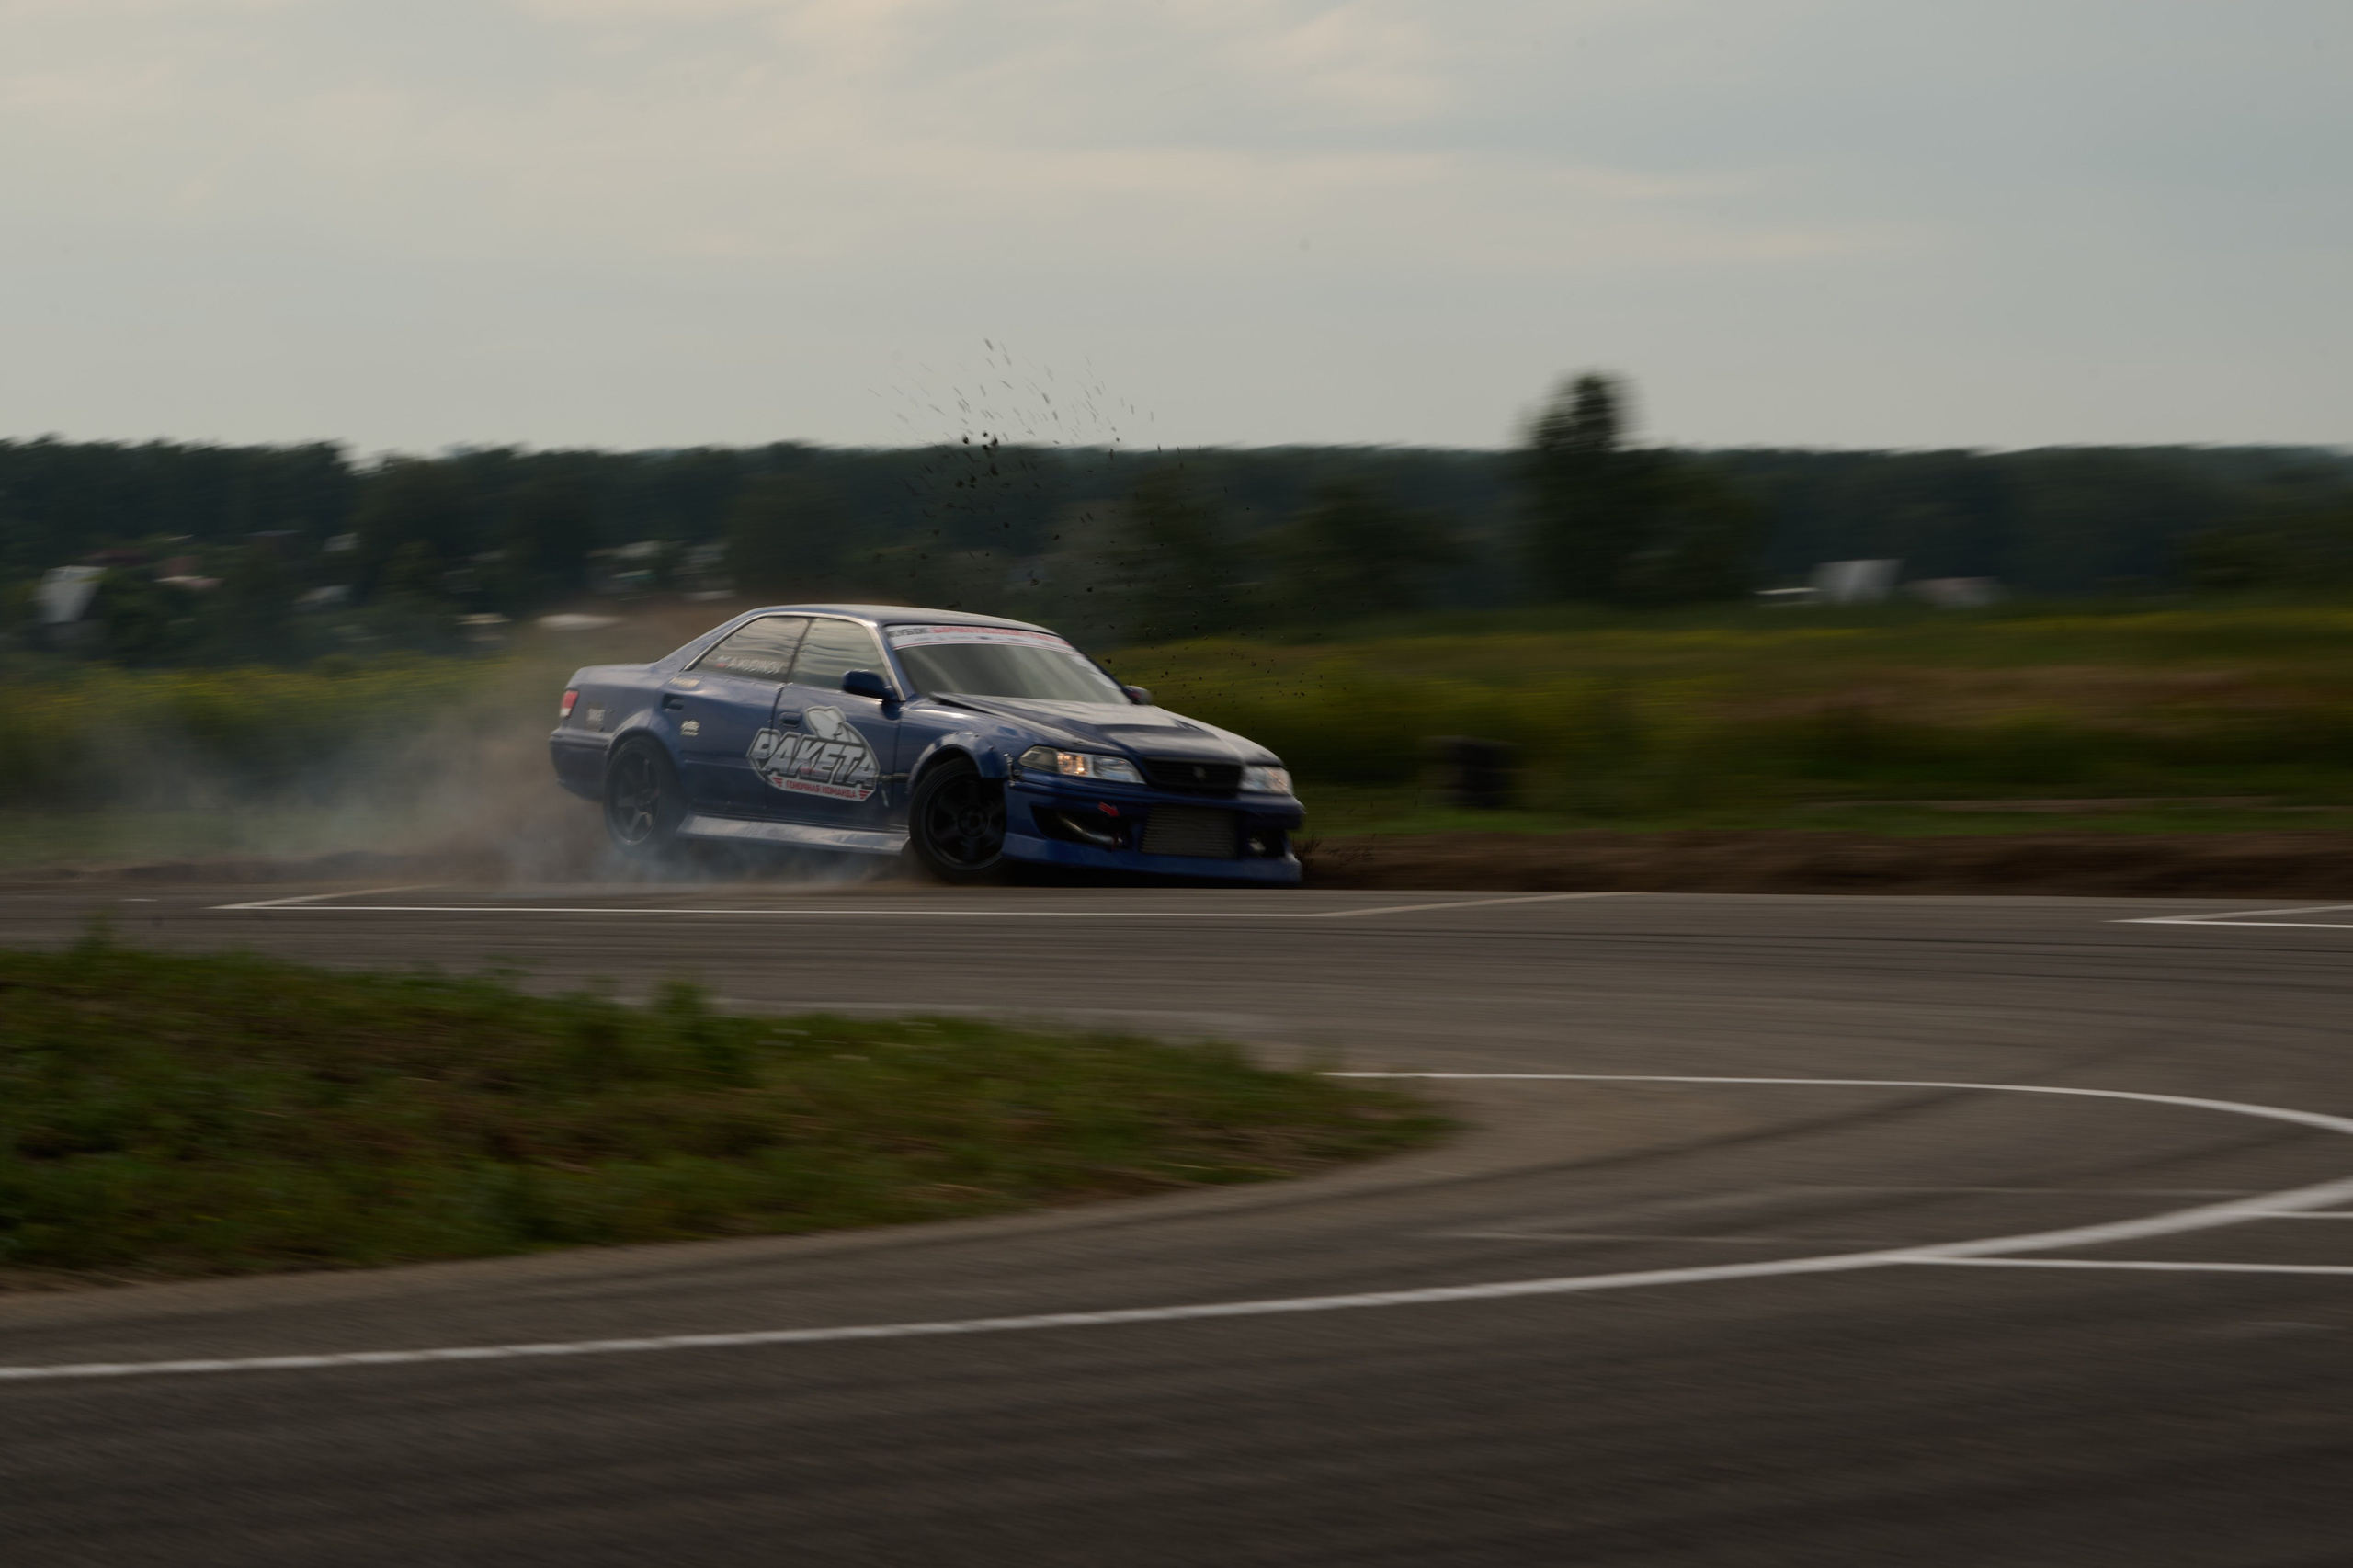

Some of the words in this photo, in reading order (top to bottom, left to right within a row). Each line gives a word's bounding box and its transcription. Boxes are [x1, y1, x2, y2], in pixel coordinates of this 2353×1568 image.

[747, 730, 877, 789] РАКЕТА
[785, 780, 820, 792] ГОНОЧНАЯ
[822, 784, 858, 798] КОМАНДА
